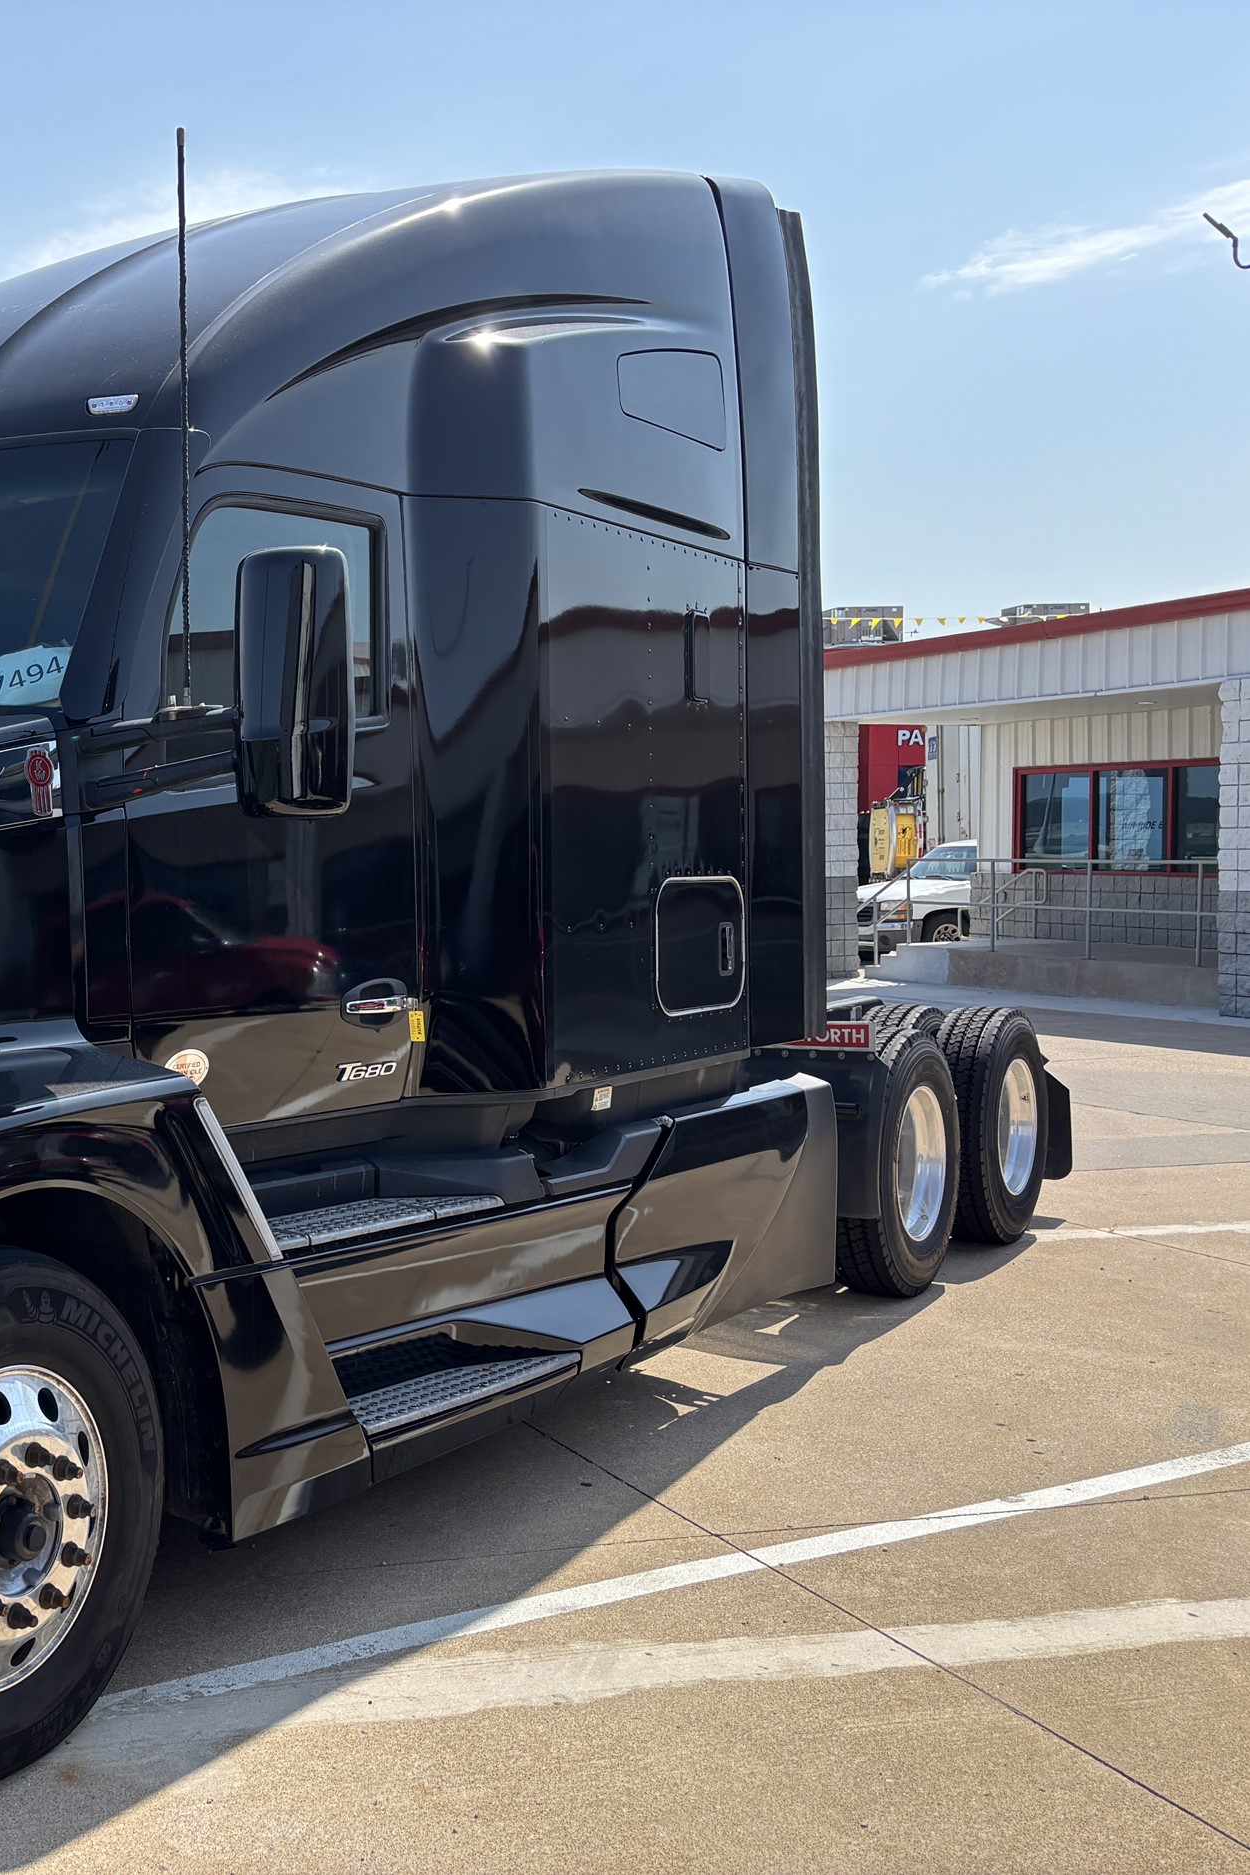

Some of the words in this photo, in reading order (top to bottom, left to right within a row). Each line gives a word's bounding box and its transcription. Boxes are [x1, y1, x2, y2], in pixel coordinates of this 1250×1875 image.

[807, 1028, 865, 1044] ORTH
[173, 1061, 200, 1070] CERTIFIED
[336, 1061, 397, 1082] T680
[60, 1296, 156, 1451] MICHELIN
